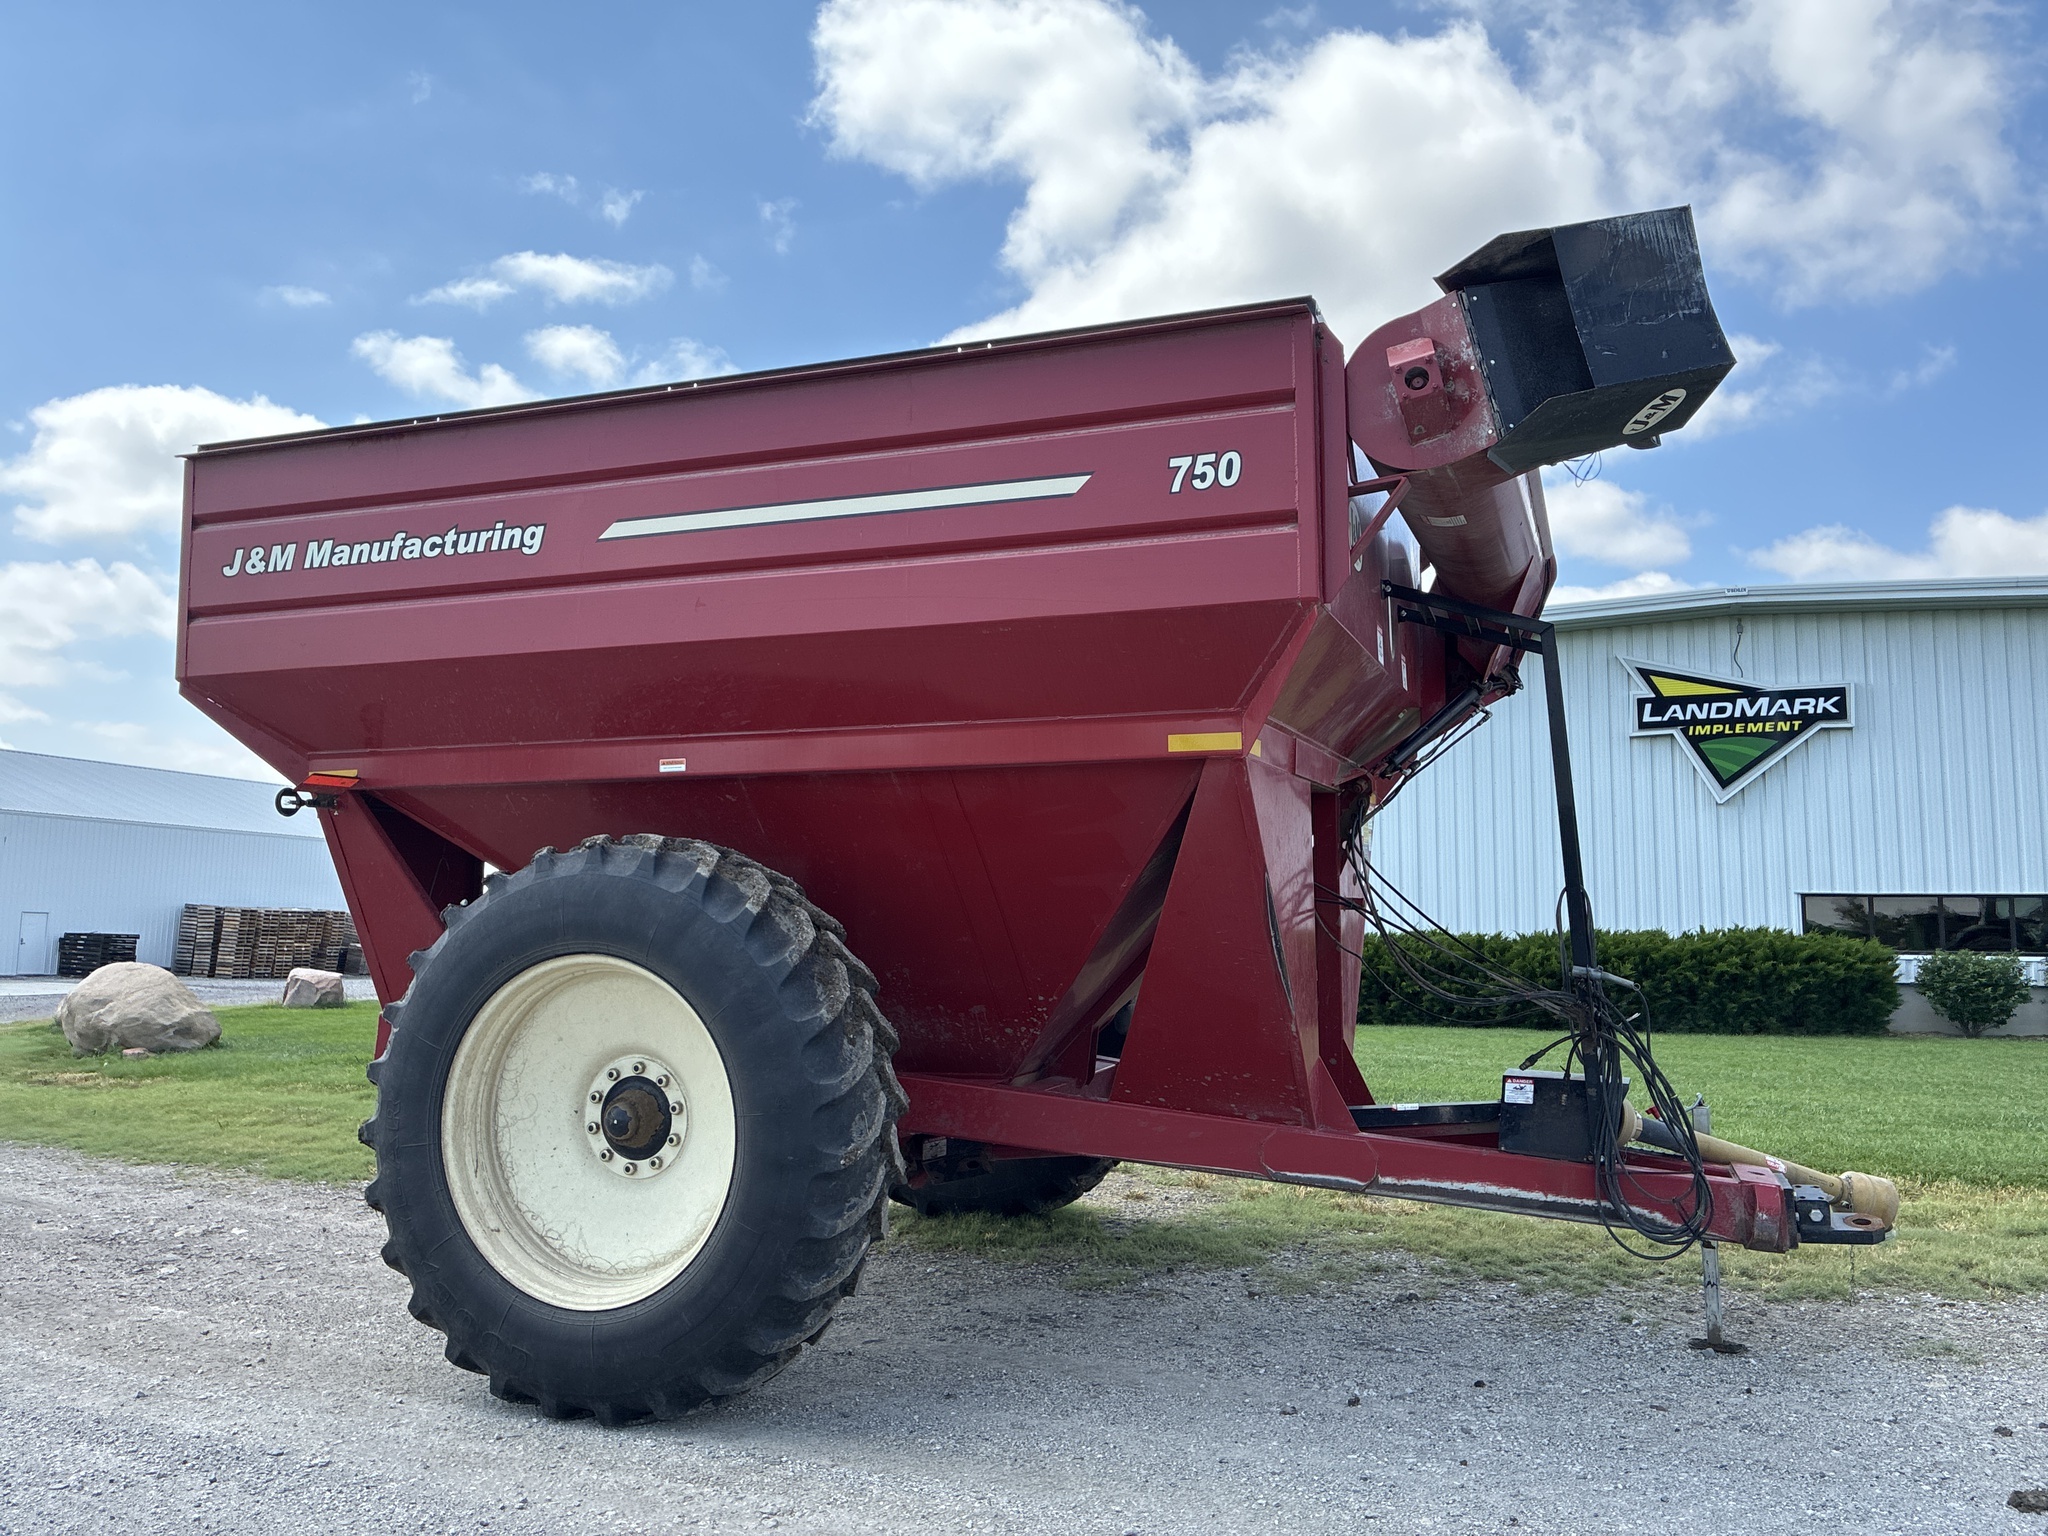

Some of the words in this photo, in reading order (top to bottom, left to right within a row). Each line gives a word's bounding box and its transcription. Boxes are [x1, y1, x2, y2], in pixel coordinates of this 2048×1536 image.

[1629, 394, 1682, 433] J&M
[1168, 450, 1242, 494] 750
[223, 544, 297, 577] J&M
[303, 521, 546, 569] Manufacturing
[1688, 720, 1803, 736] IMPLEMENT
